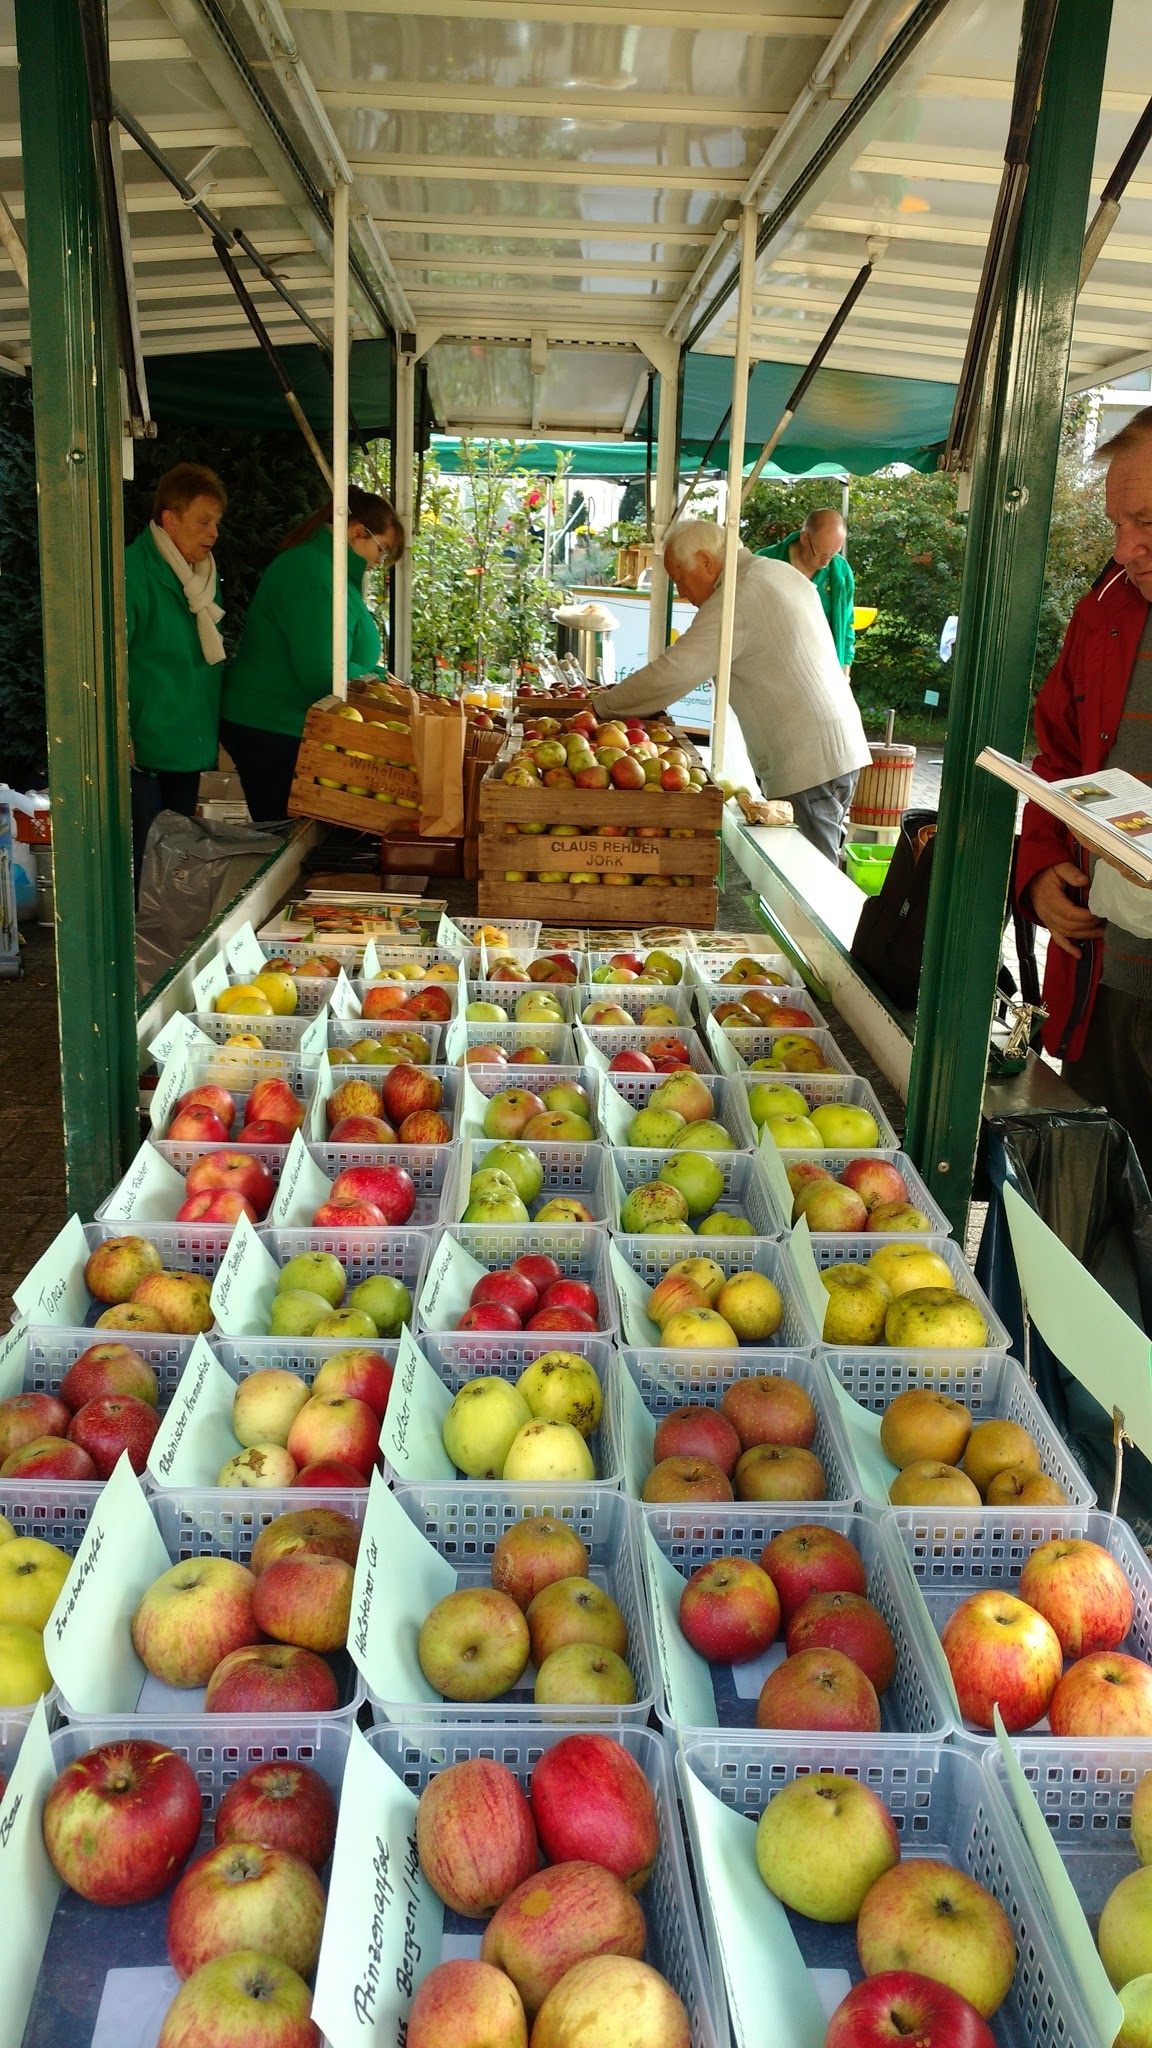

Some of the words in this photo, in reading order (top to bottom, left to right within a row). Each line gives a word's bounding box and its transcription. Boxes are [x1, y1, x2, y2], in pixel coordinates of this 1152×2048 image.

[350, 757, 406, 781] Wilhelm
[551, 841, 599, 853] CLAUS
[603, 842, 660, 856] REHDER
[586, 855, 623, 867] JORK
[121, 1190, 138, 1220] Jacob
[132, 1160, 149, 1188] Fischer
[38, 1278, 67, 1318] Topaz
[158, 1410, 188, 1477] Rheinischer
[182, 1354, 211, 1415] Krummstiel
[391, 1397, 411, 1460] Gelber
[404, 1343, 420, 1395] Richard
[55, 1526, 105, 1641] Zwiebelapfel
[353, 1570, 375, 1658] Holsteiner
[354, 1836, 393, 2026] Prinzenapfel
